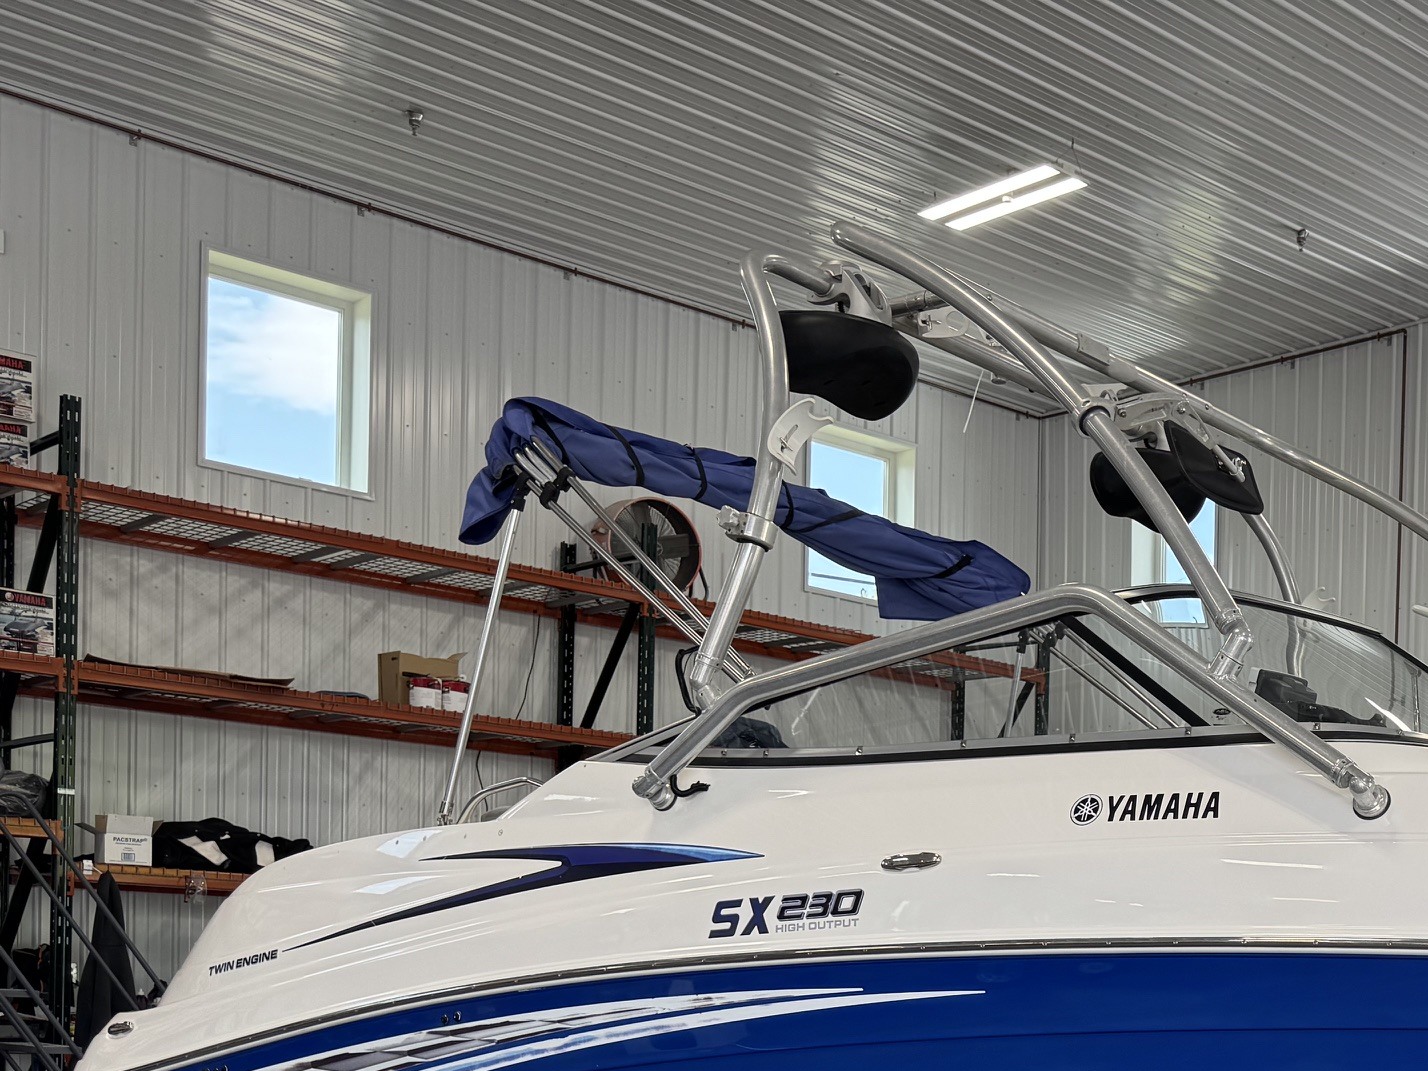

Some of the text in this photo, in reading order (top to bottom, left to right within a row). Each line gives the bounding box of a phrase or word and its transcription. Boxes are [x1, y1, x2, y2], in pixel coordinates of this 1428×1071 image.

[14, 593, 47, 606] YAMAHA
[1107, 791, 1220, 822] YAMAHA
[775, 918, 860, 933] HIGH OUTPUT
[208, 949, 278, 977] TWIN ENGINE
